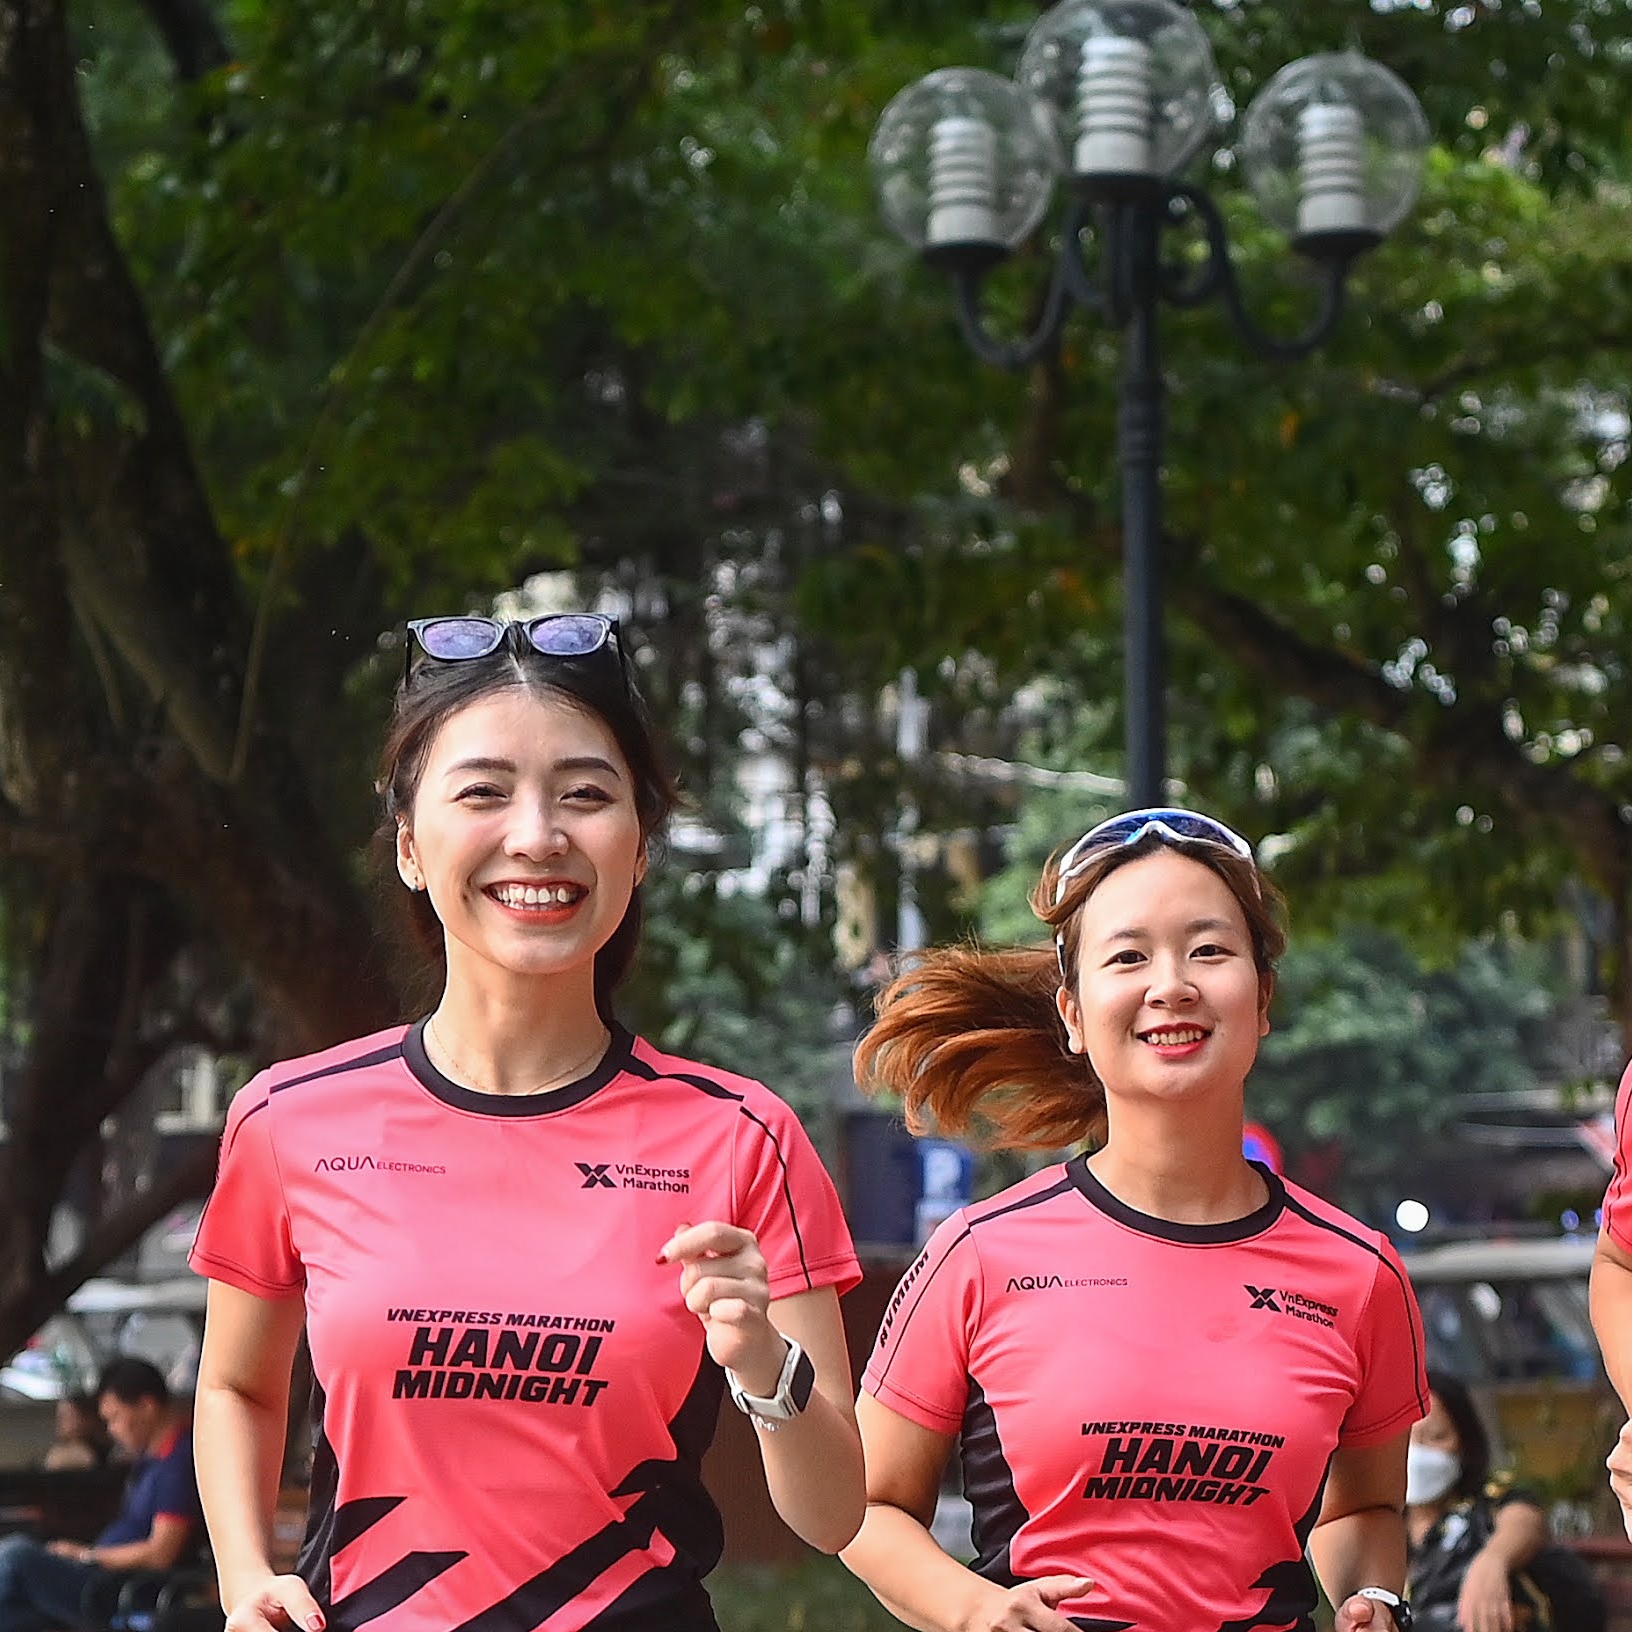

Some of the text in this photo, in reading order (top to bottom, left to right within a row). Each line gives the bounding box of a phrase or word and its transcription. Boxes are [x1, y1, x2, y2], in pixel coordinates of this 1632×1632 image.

[314, 1156, 446, 1175] AQUA ELECTRONICS
[615, 1164, 690, 1179] VnExpress
[623, 1177, 690, 1194] Marathon
[1005, 1276, 1128, 1293] AQUA ELECTRONICS
[1279, 1290, 1339, 1317] VnExpress
[387, 1308, 615, 1333] VNEXPRESS MARATHON
[1285, 1305, 1335, 1329] Marathon
[408, 1327, 602, 1374] HANOI
[391, 1369, 608, 1407] MIDNIGHT
[1081, 1421, 1286, 1447] VNEXPRESS MARATHON
[1102, 1436, 1272, 1482] HANOI
[1083, 1475, 1271, 1506] MIDNIGHT
